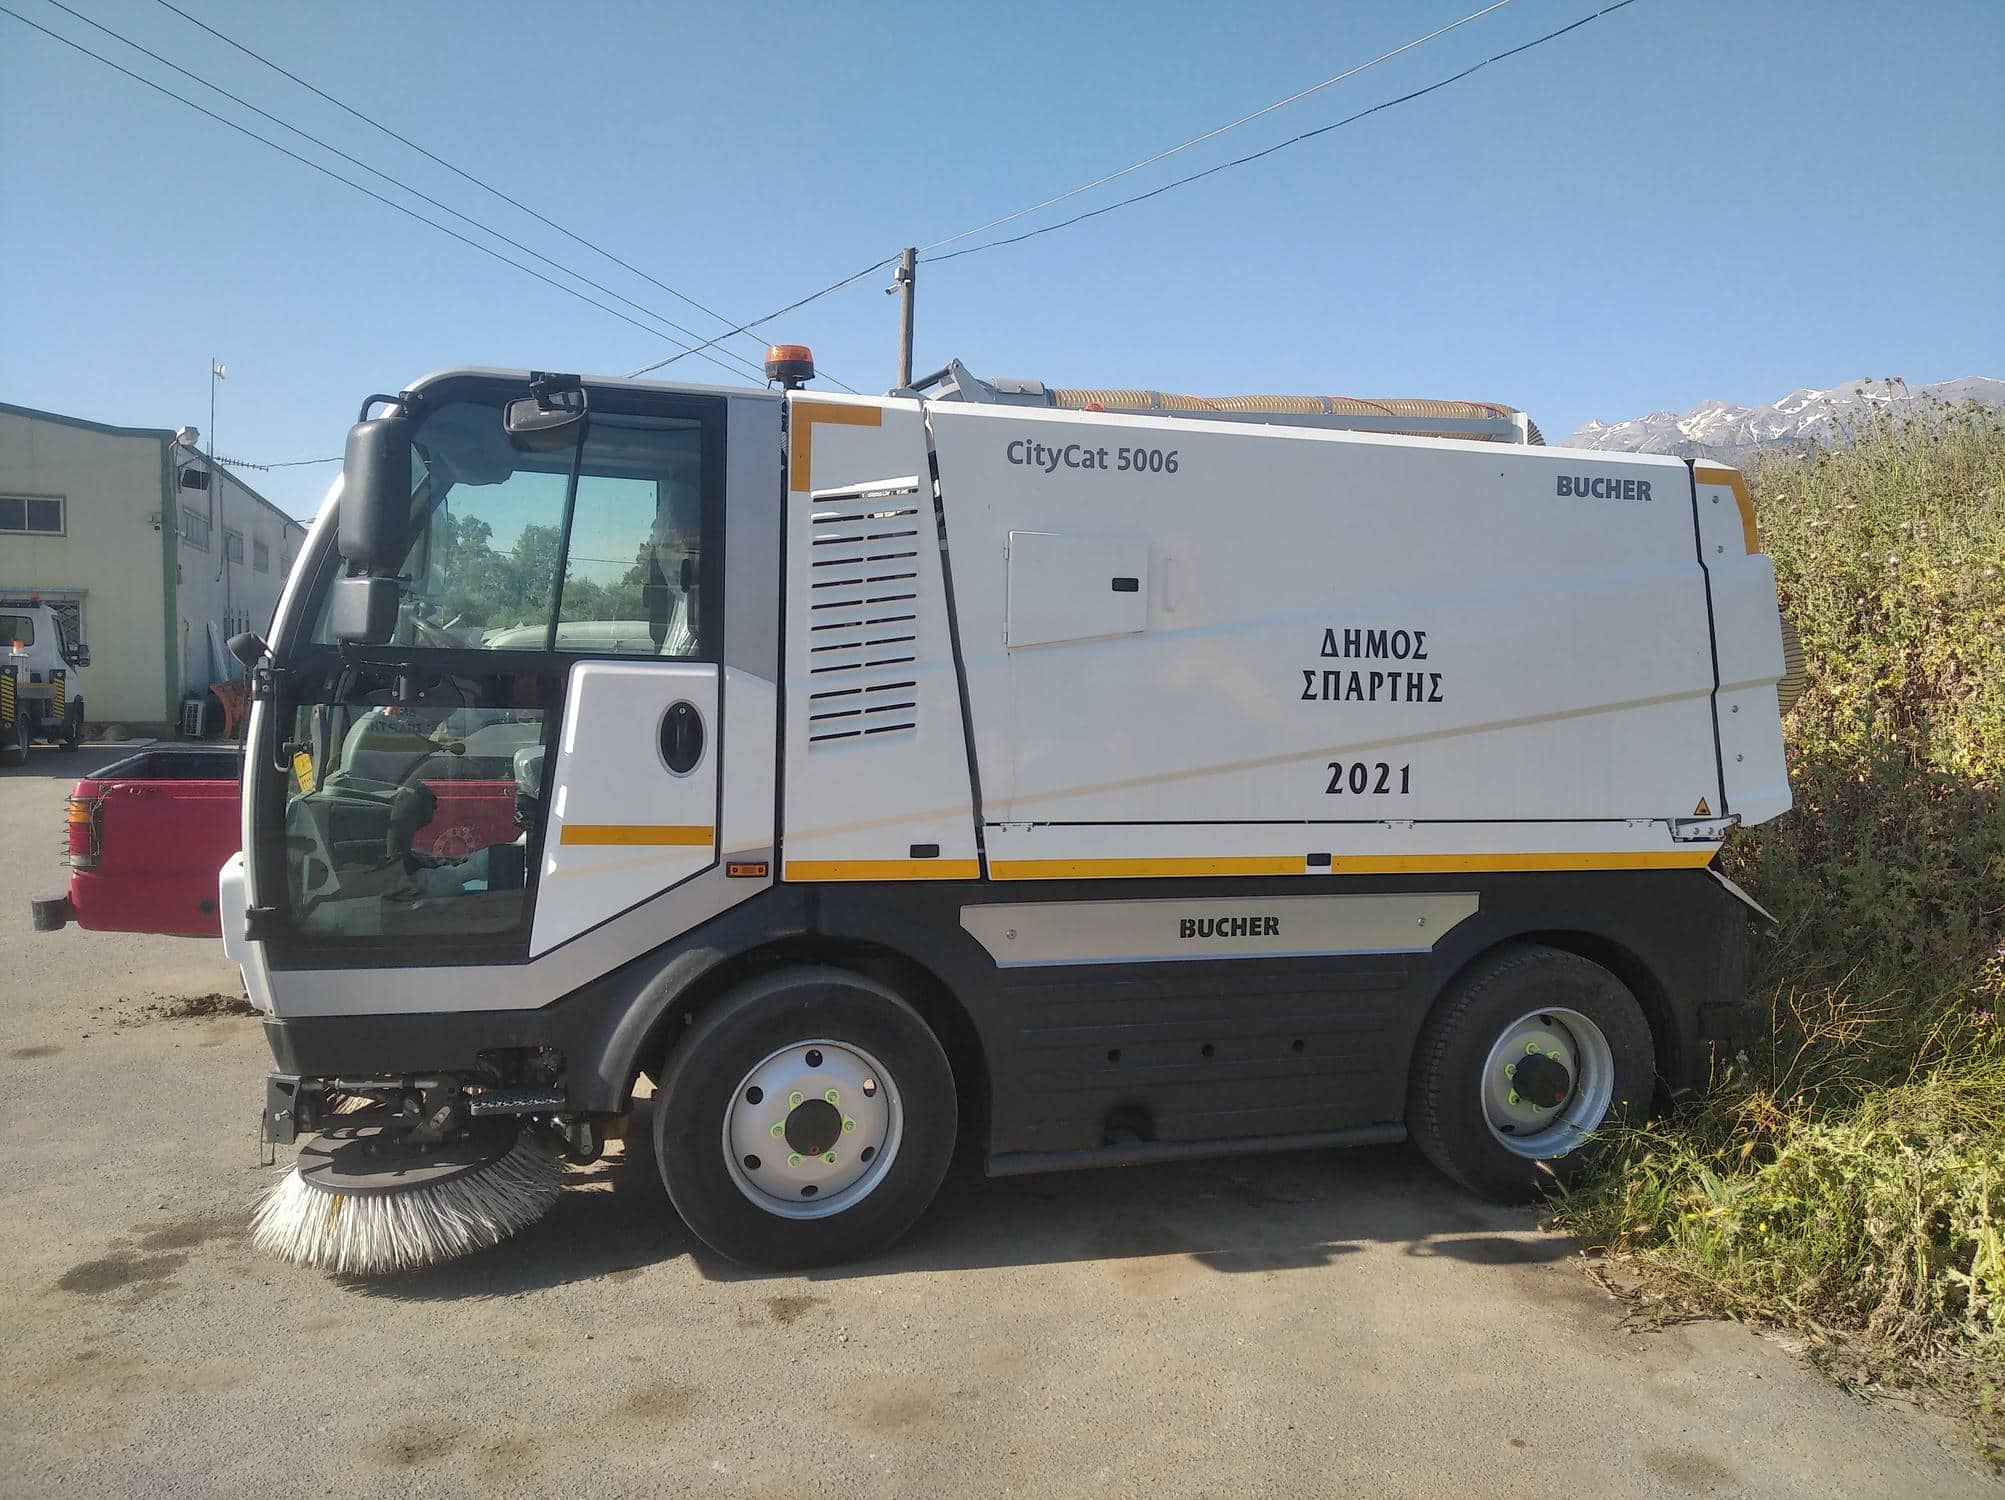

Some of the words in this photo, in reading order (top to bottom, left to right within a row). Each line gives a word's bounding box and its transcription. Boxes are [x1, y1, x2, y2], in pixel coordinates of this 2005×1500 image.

[1006, 438, 1109, 475] CityCat
[1117, 447, 1179, 475] 5006
[1557, 475, 1652, 501] BUCHER
[1319, 627, 1429, 661] ΔΗΜΟΣ
[1300, 669, 1444, 703] ΣΠΑΡΤΗΣ
[1324, 761, 1410, 795] 2021
[1179, 916, 1281, 939] BUCHER
